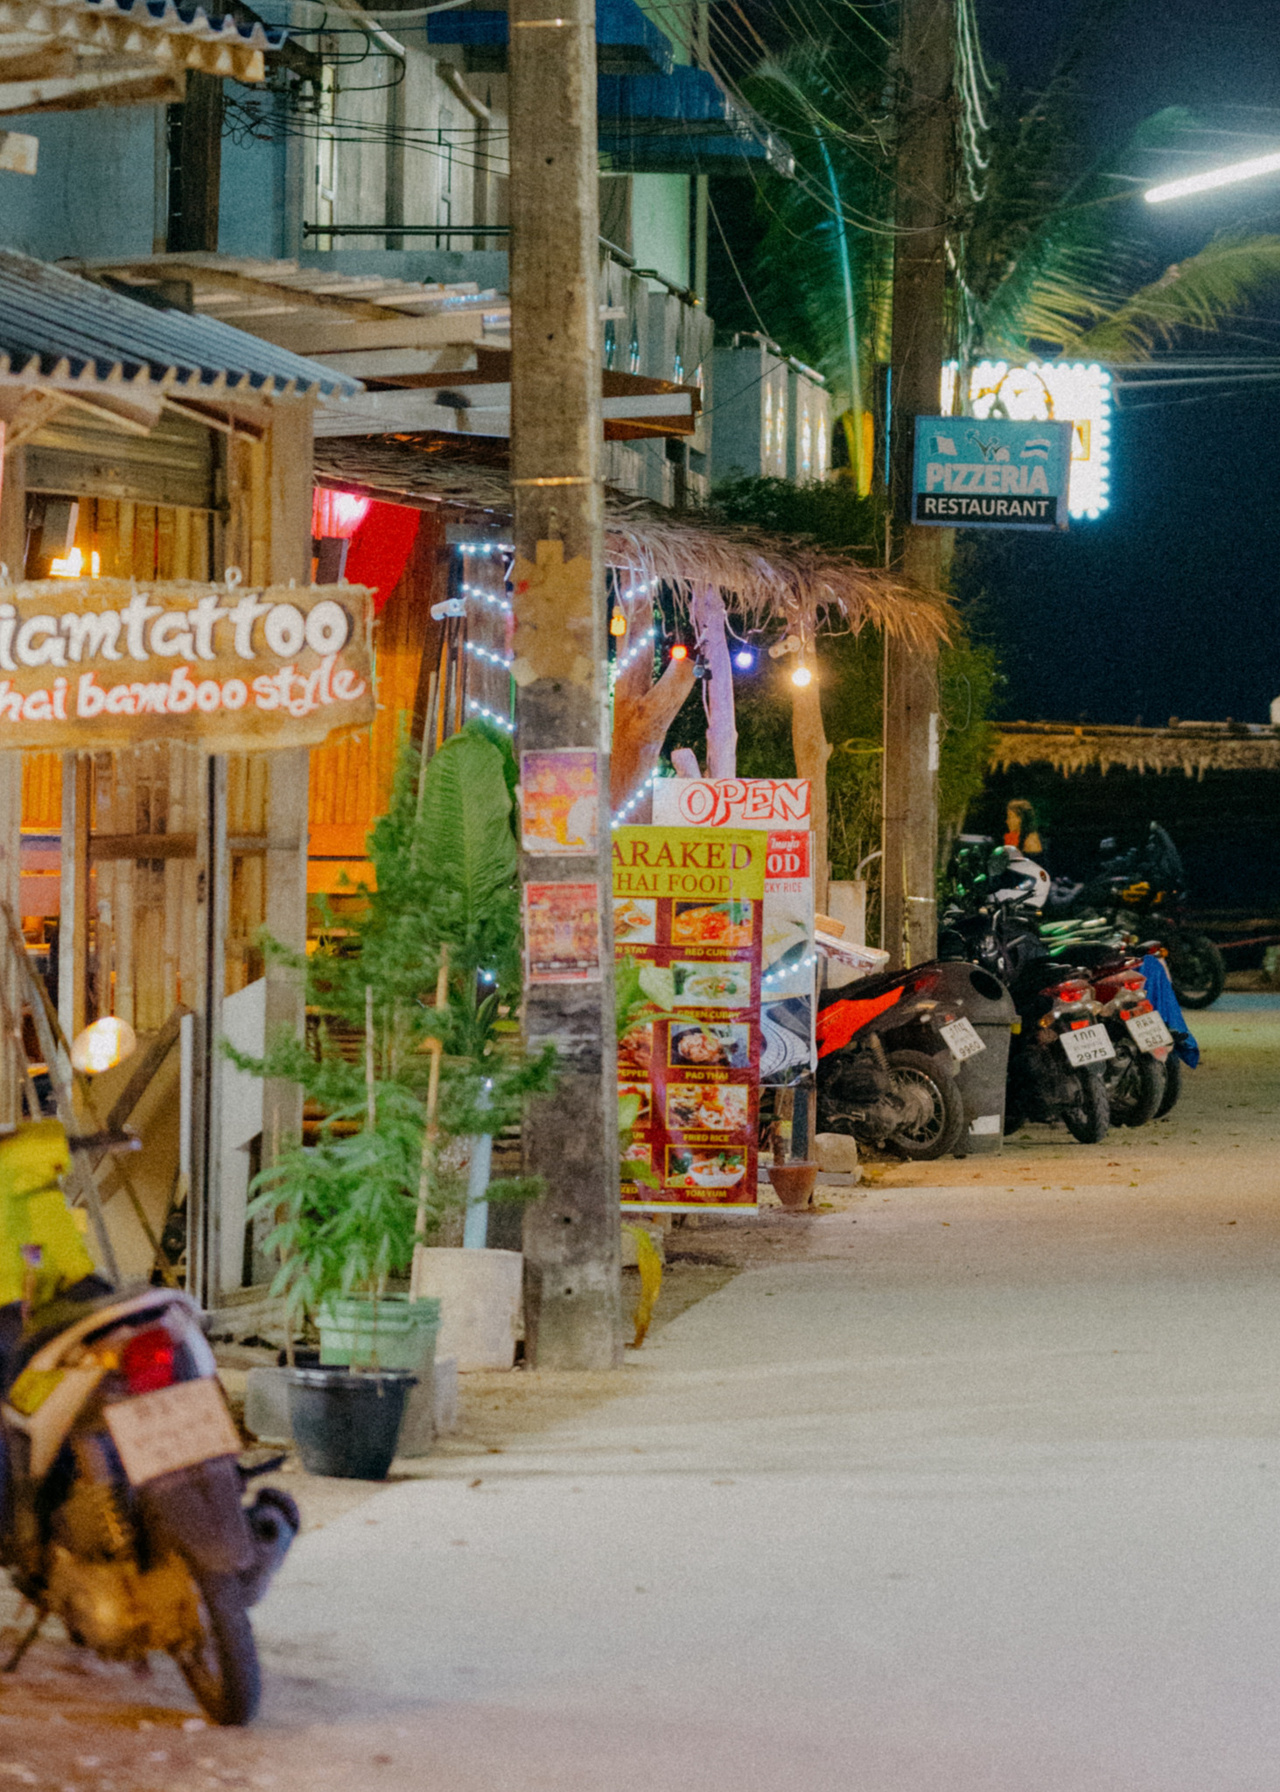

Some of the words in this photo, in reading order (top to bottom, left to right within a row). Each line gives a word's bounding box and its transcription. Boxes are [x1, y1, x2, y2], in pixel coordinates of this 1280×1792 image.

[925, 462, 1050, 495] PIZZERIA
[924, 496, 1050, 517] RESTAURANT
[77, 666, 248, 718] bamboo
[253, 654, 366, 717] style
[679, 778, 812, 827] OPEN
[612, 841, 752, 870] ARAKED
[669, 874, 733, 894] FOOD
[784, 883, 802, 893] RICE
[685, 948, 704, 957] RED
[706, 948, 738, 957] CURRY
[709, 1010, 740, 1019] CURRY
[1076, 1048, 1107, 1063] 2975
[685, 1071, 705, 1080] PAD
[707, 1072, 729, 1081] THAI
[683, 1133, 708, 1142] FRIED
[710, 1134, 730, 1143] RICE
